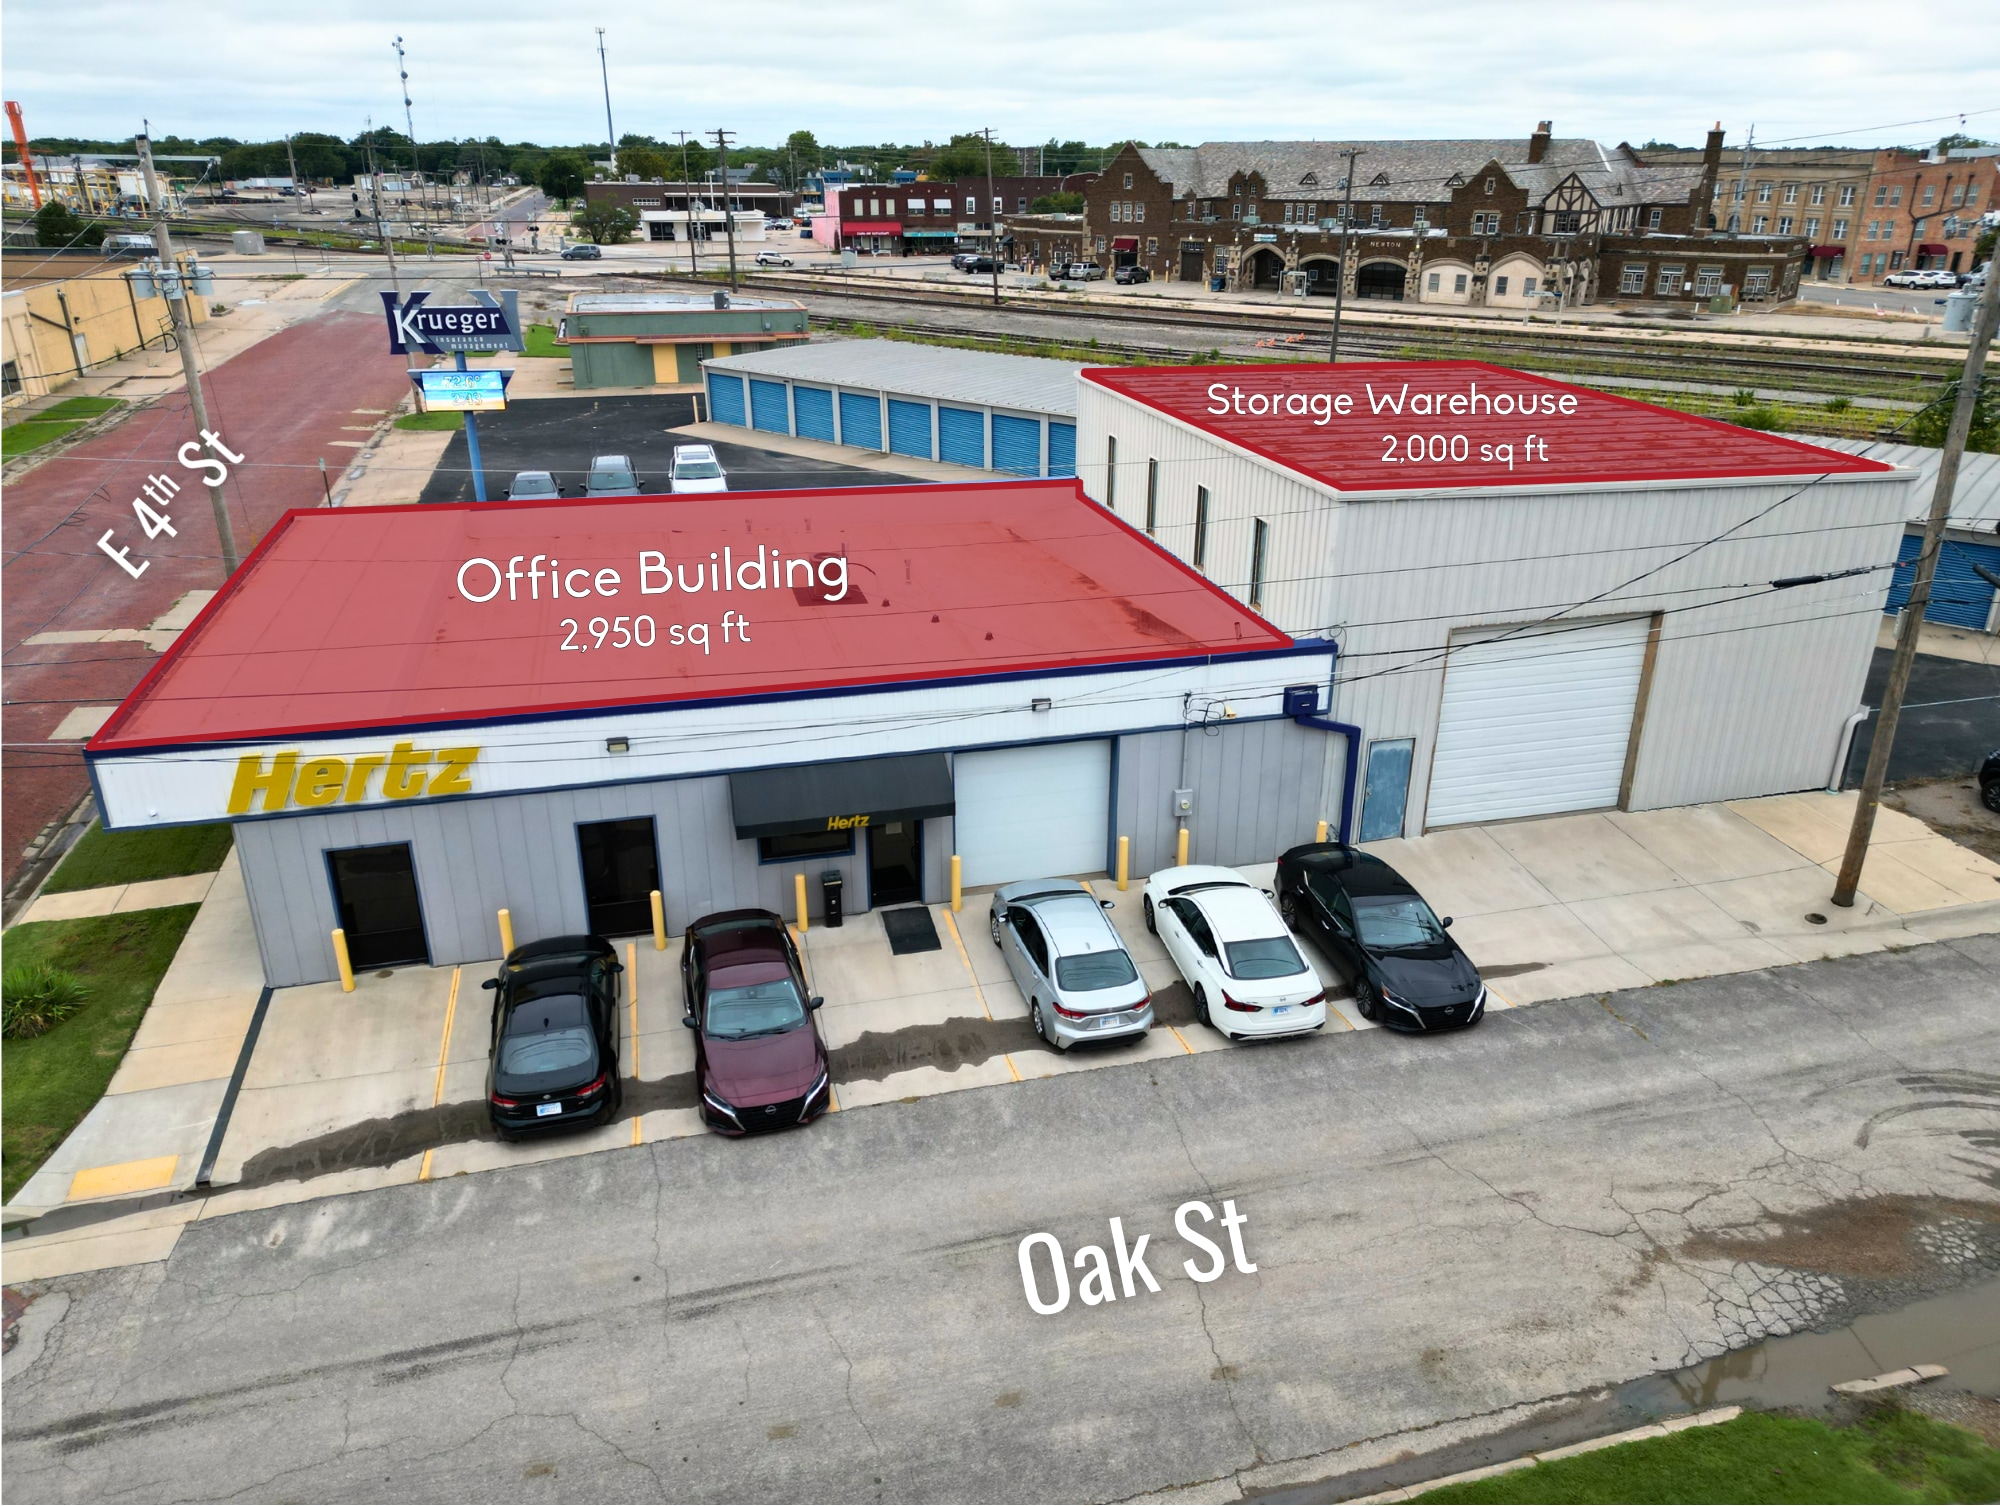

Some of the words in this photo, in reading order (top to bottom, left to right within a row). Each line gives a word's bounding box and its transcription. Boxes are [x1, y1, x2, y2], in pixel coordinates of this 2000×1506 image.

[392, 309, 500, 344] Krueger
[450, 342, 509, 350] management
[226, 740, 482, 815] Hertz
[826, 814, 870, 831] Hertz
